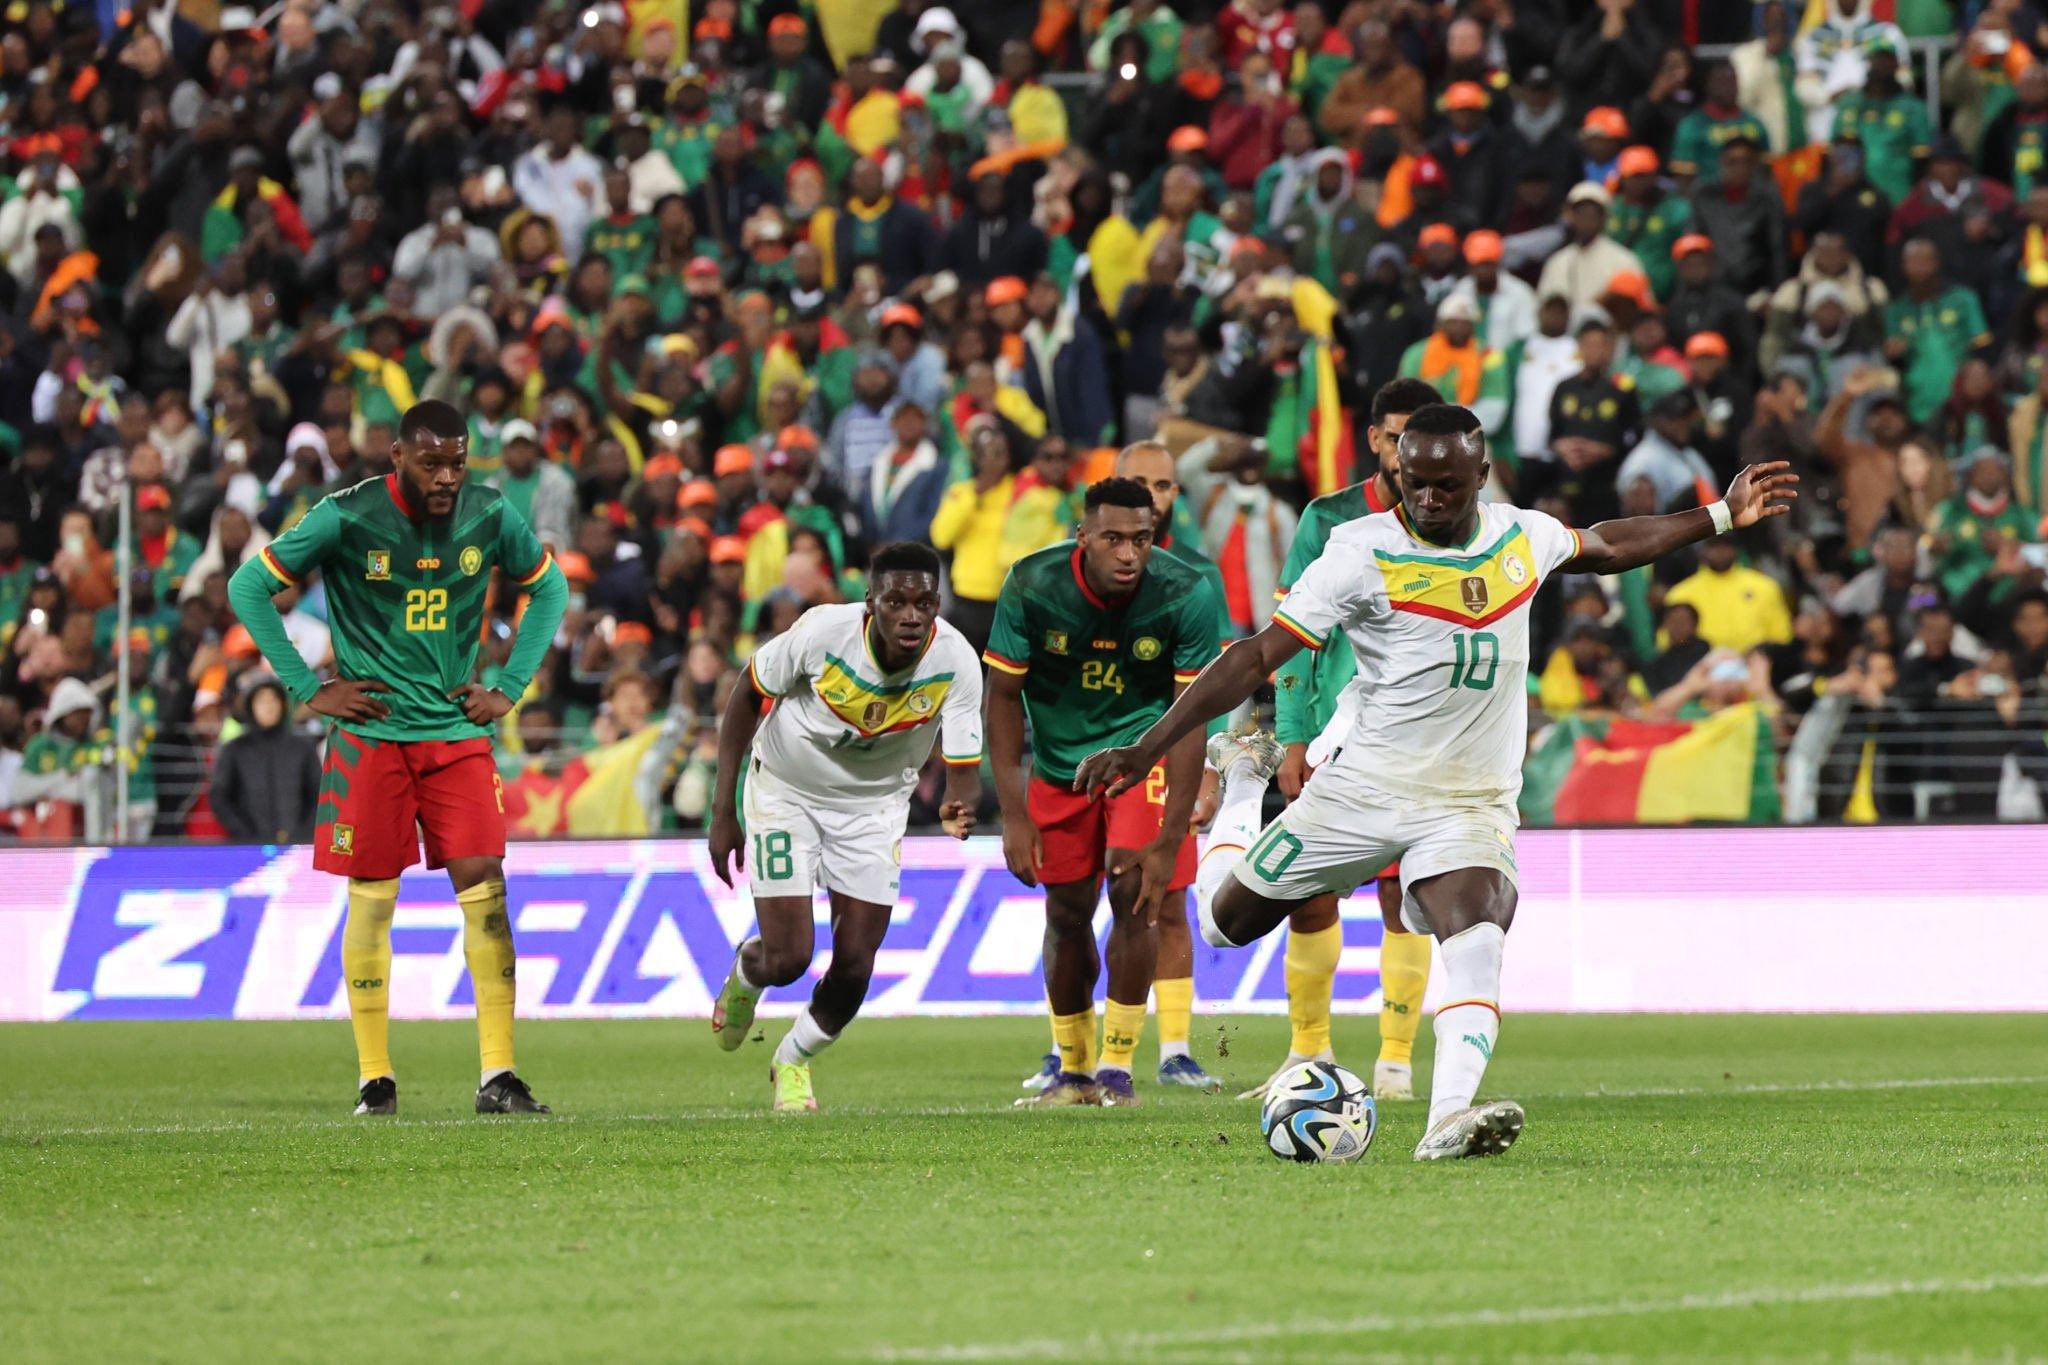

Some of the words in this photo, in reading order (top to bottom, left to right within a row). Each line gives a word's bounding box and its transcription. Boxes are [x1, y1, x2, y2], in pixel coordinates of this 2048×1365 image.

[416, 558, 440, 569] one
[1403, 580, 1431, 593] PUMA
[406, 589, 447, 632] 22
[1092, 639, 1118, 650] one
[1449, 632, 1499, 691] 10
[1081, 660, 1126, 695] 24
[1145, 765, 1169, 806] 2
[754, 831, 794, 881] 18
[1245, 820, 1304, 882] 10
[352, 978, 383, 989] one
